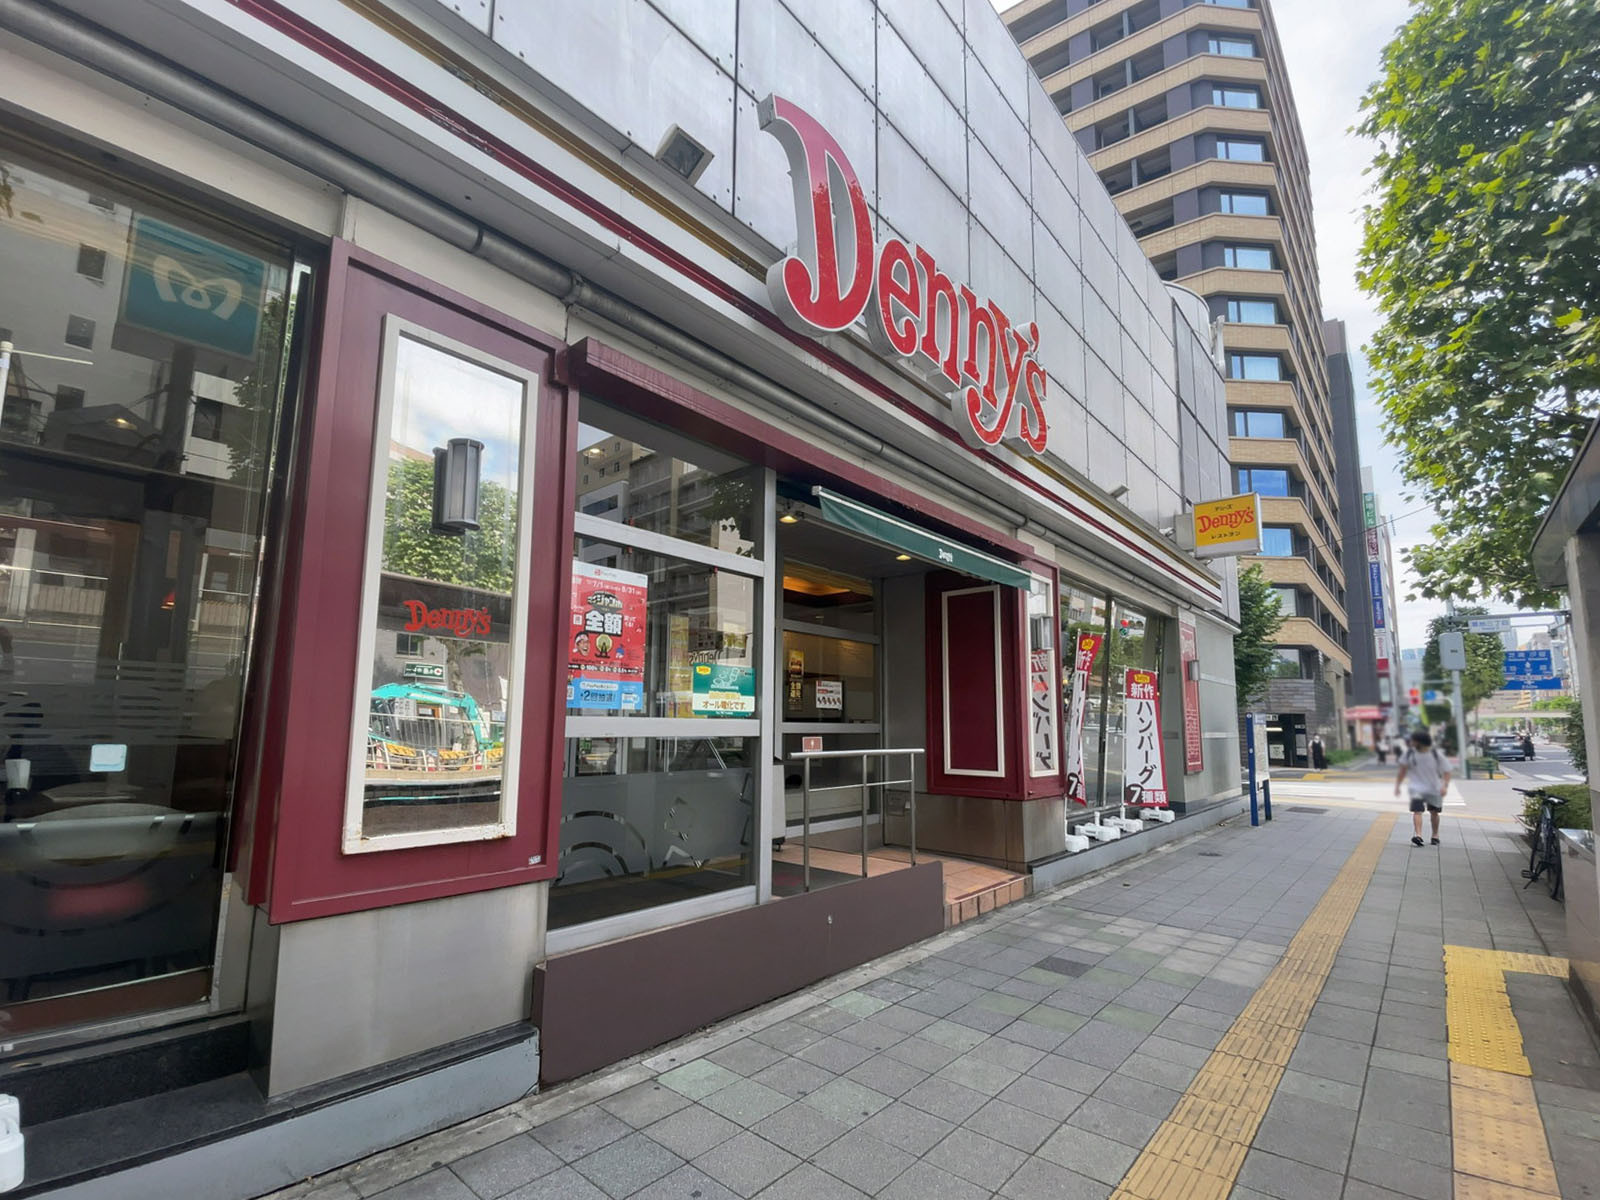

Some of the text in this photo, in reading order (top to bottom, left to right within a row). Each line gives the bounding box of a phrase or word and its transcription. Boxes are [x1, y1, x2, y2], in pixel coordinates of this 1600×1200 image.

[768, 94, 1047, 454] Denny's
[1197, 506, 1255, 533] Denny's
[403, 600, 492, 637] Denny's
[585, 611, 623, 635] 全額
[1131, 683, 1154, 699] 新作
[703, 701, 745, 710] オール電化です
[1137, 701, 1157, 784] ハンバーグ
[1129, 786, 1167, 803] 7種類
